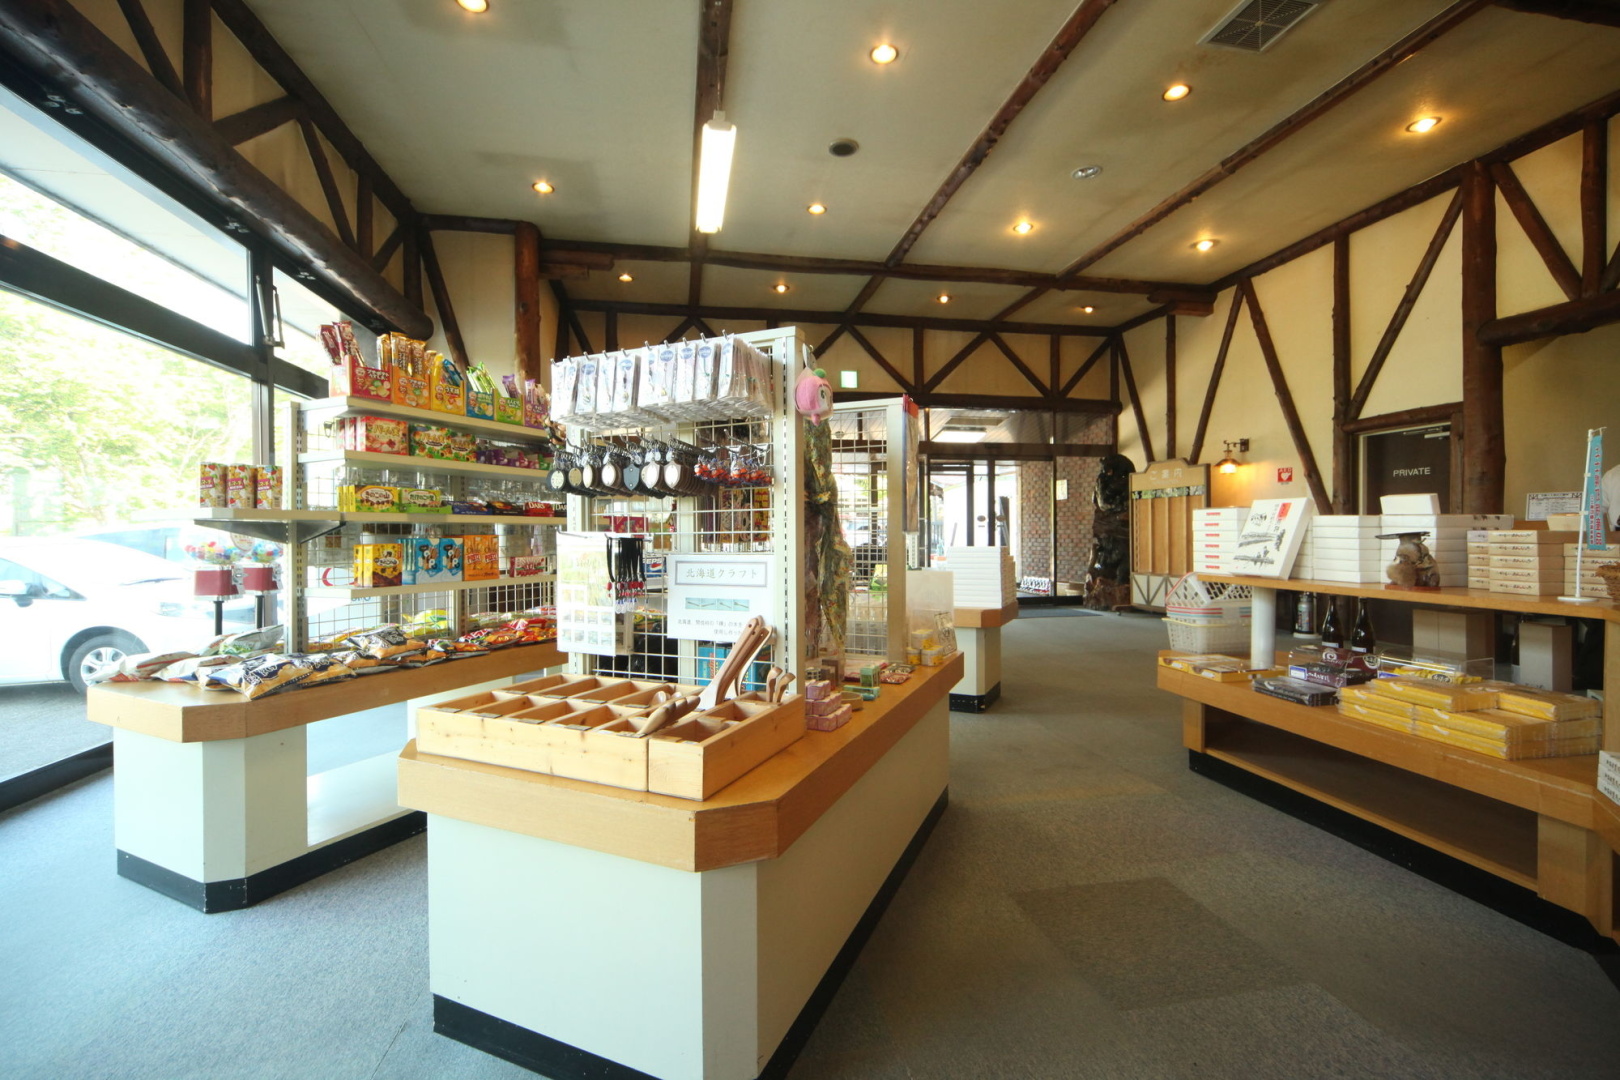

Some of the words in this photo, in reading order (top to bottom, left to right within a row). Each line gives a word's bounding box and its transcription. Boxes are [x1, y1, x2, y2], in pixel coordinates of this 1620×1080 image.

[1393, 466, 1431, 477] PRIVATE
[556, 503, 567, 511] DAR
[686, 567, 757, 579] 北海道クラフト
